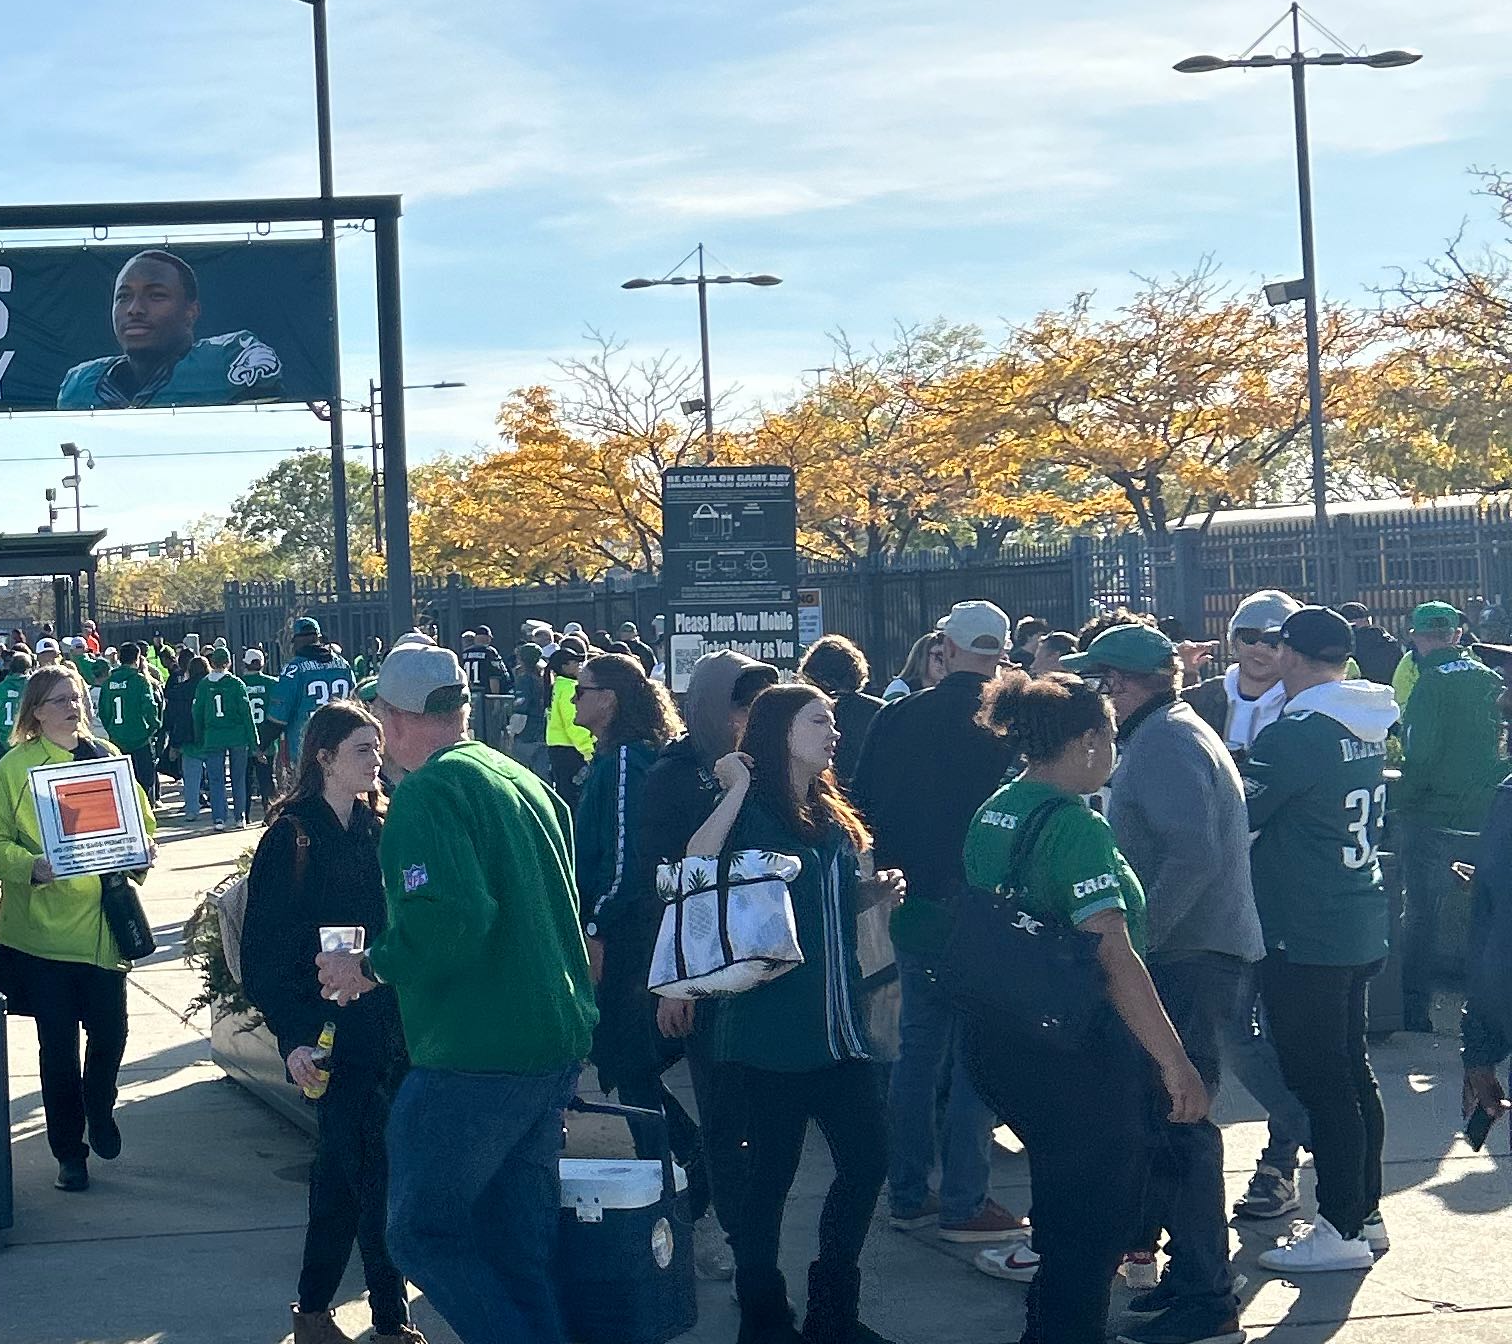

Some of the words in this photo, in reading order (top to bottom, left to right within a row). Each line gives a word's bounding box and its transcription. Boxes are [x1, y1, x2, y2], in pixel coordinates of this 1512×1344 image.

[737, 474, 768, 482] GAME
[769, 474, 791, 482] DAY
[675, 613, 709, 632] Please
[710, 612, 735, 632] Have
[736, 612, 758, 631] Your
[759, 611, 793, 631] Mobile
[762, 642, 775, 658] as
[775, 638, 794, 658] You
[4, 702, 14, 726] 1
[214, 694, 224, 717] 1
